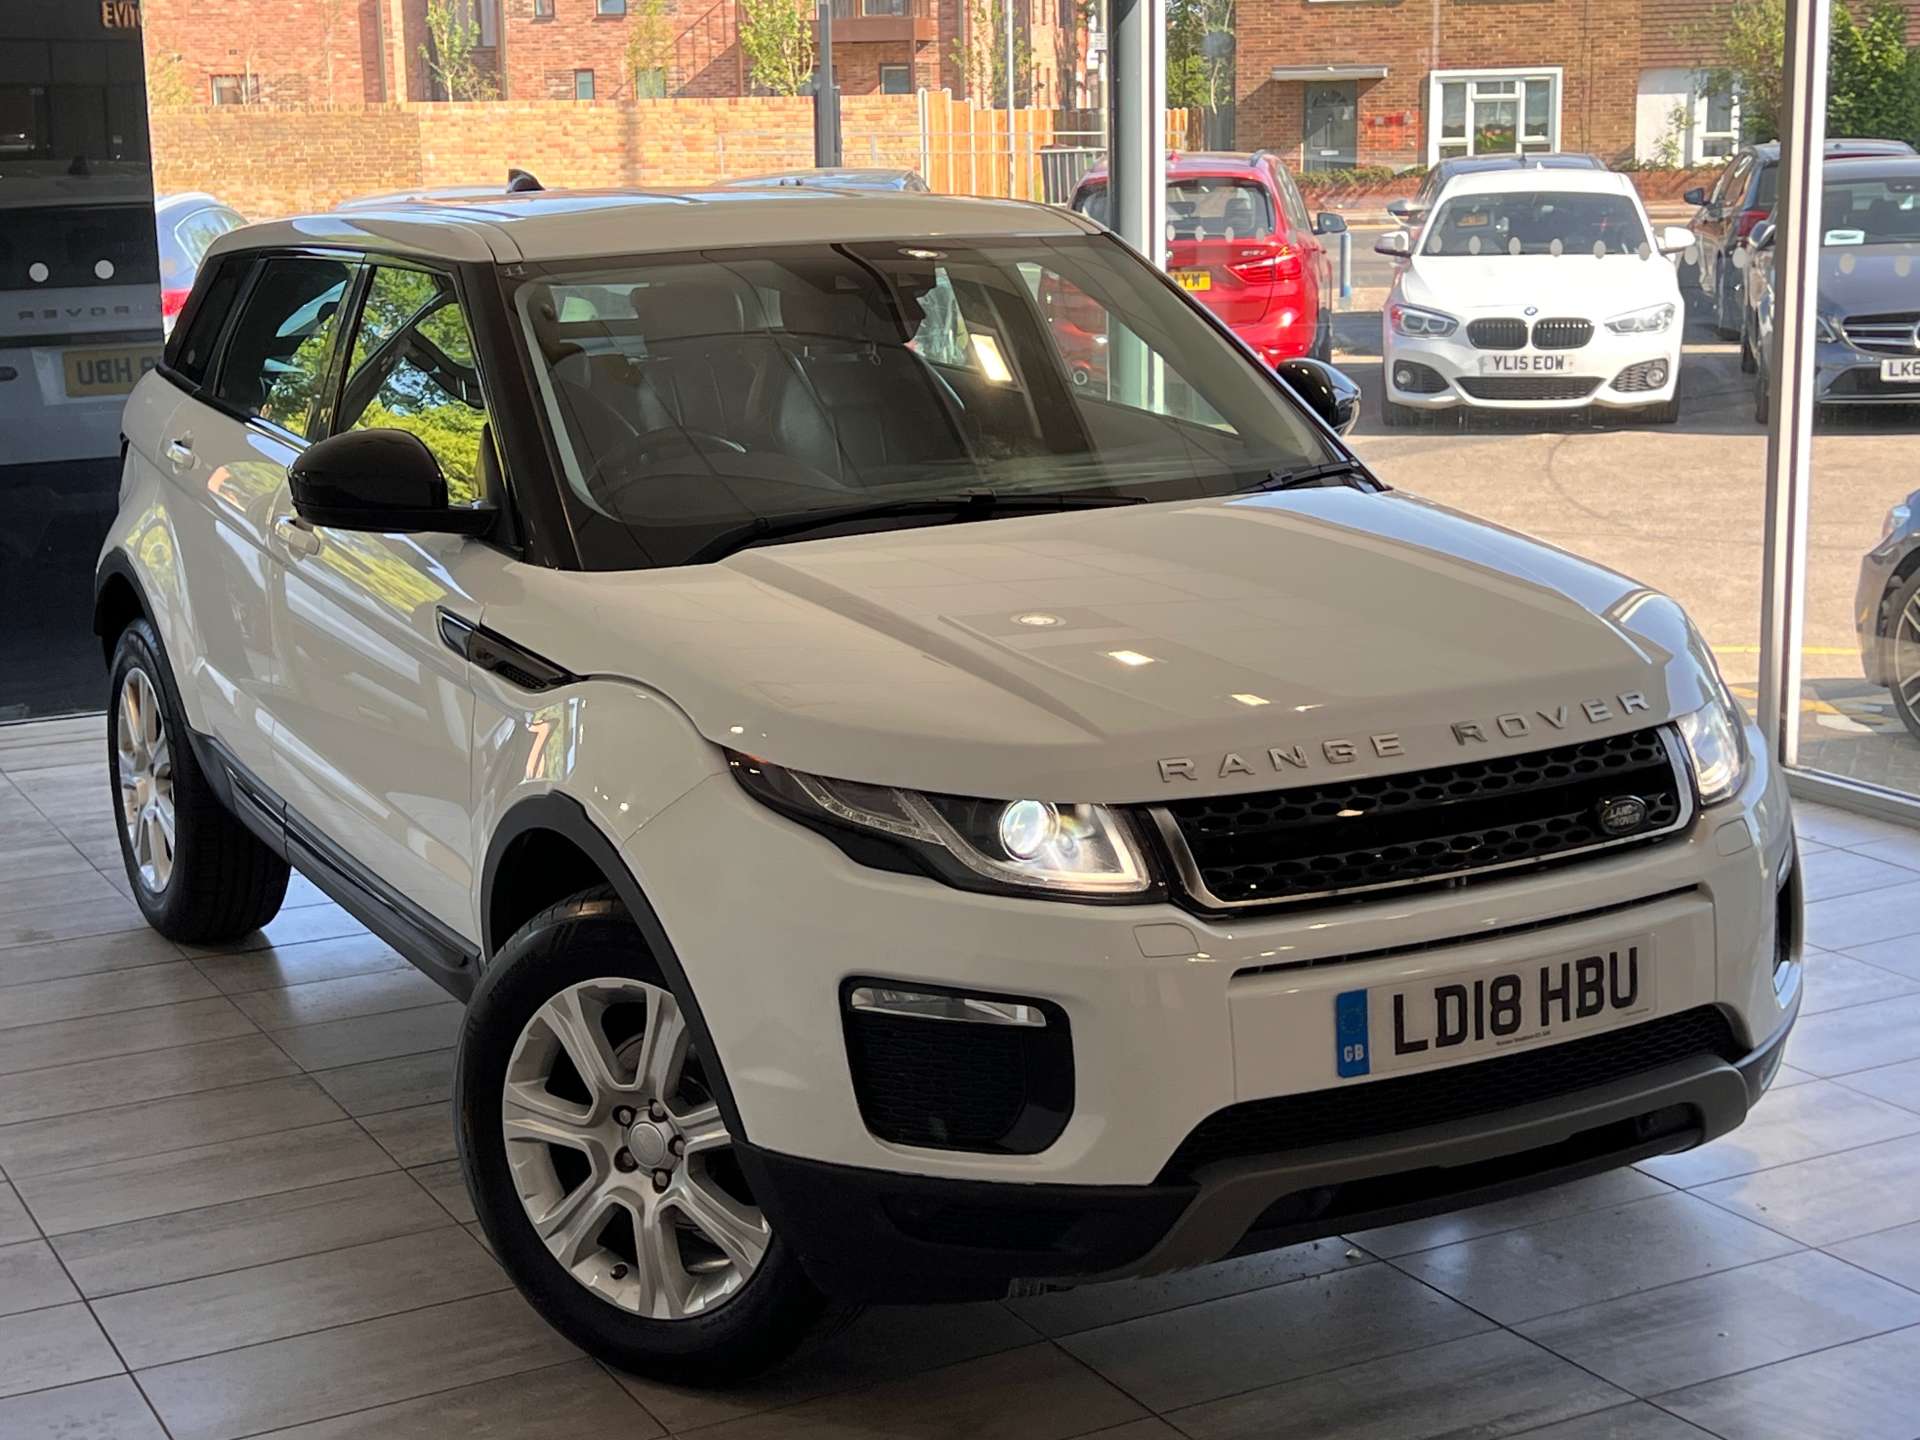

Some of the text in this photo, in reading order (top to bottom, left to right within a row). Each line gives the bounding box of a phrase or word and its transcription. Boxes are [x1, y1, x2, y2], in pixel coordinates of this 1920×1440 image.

[1493, 355, 1564, 370] YL15 EOW
[1157, 690, 1650, 783] RANGE ROVER
[1610, 804, 1633, 818] LAND
[1614, 812, 1641, 826] ROVER
[1393, 947, 1638, 1056] LD18 HBU
[1343, 1044, 1364, 1063] GB
